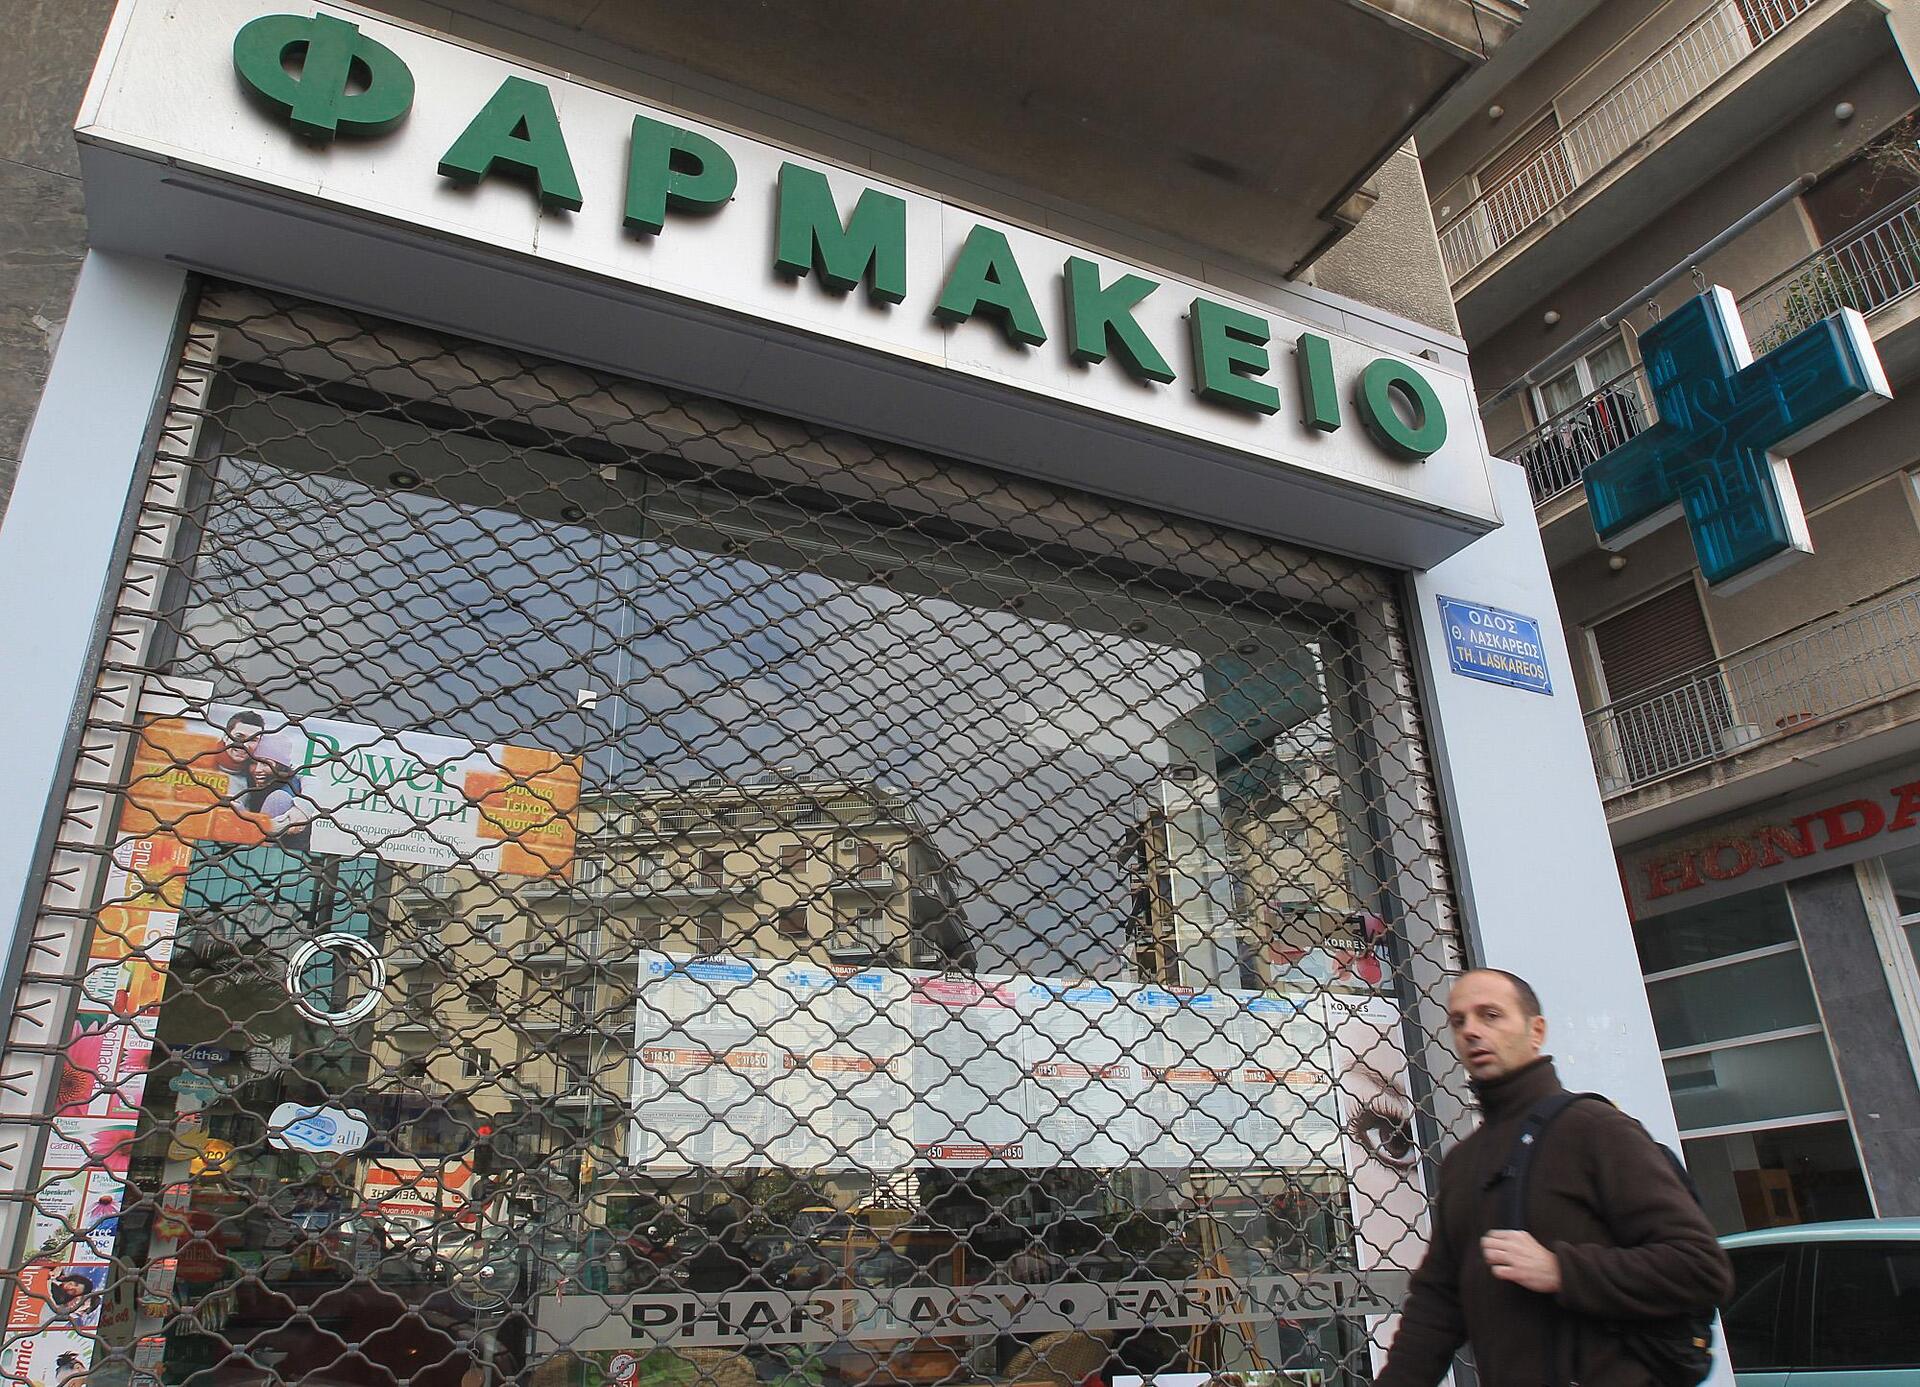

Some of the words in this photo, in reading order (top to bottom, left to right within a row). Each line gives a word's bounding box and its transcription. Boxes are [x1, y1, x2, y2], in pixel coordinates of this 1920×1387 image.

[233, 12, 1448, 462] ΦΑΡΜΑΚΕΙΟ
[1469, 610, 1518, 634] ΟΔΟΣ
[1451, 625, 1466, 641] Θ.
[1470, 629, 1540, 659] ΛΑΣΚΑΡΕΩΣ
[1456, 646, 1477, 664] TH.
[1479, 650, 1544, 679] LASKAREOS
[344, 787, 468, 823] HEALTH
[371, 840, 426, 853] αρμακείο
[129, 840, 153, 897] ormula
[1324, 937, 1366, 950] KORRES
[97, 1021, 120, 1086] echinace
[650, 1050, 676, 1062] 11850
[336, 1130, 361, 1146] alli
[631, 1292, 1030, 1339] PHARMACY
[1107, 1280, 1381, 1321] FARMACIA
